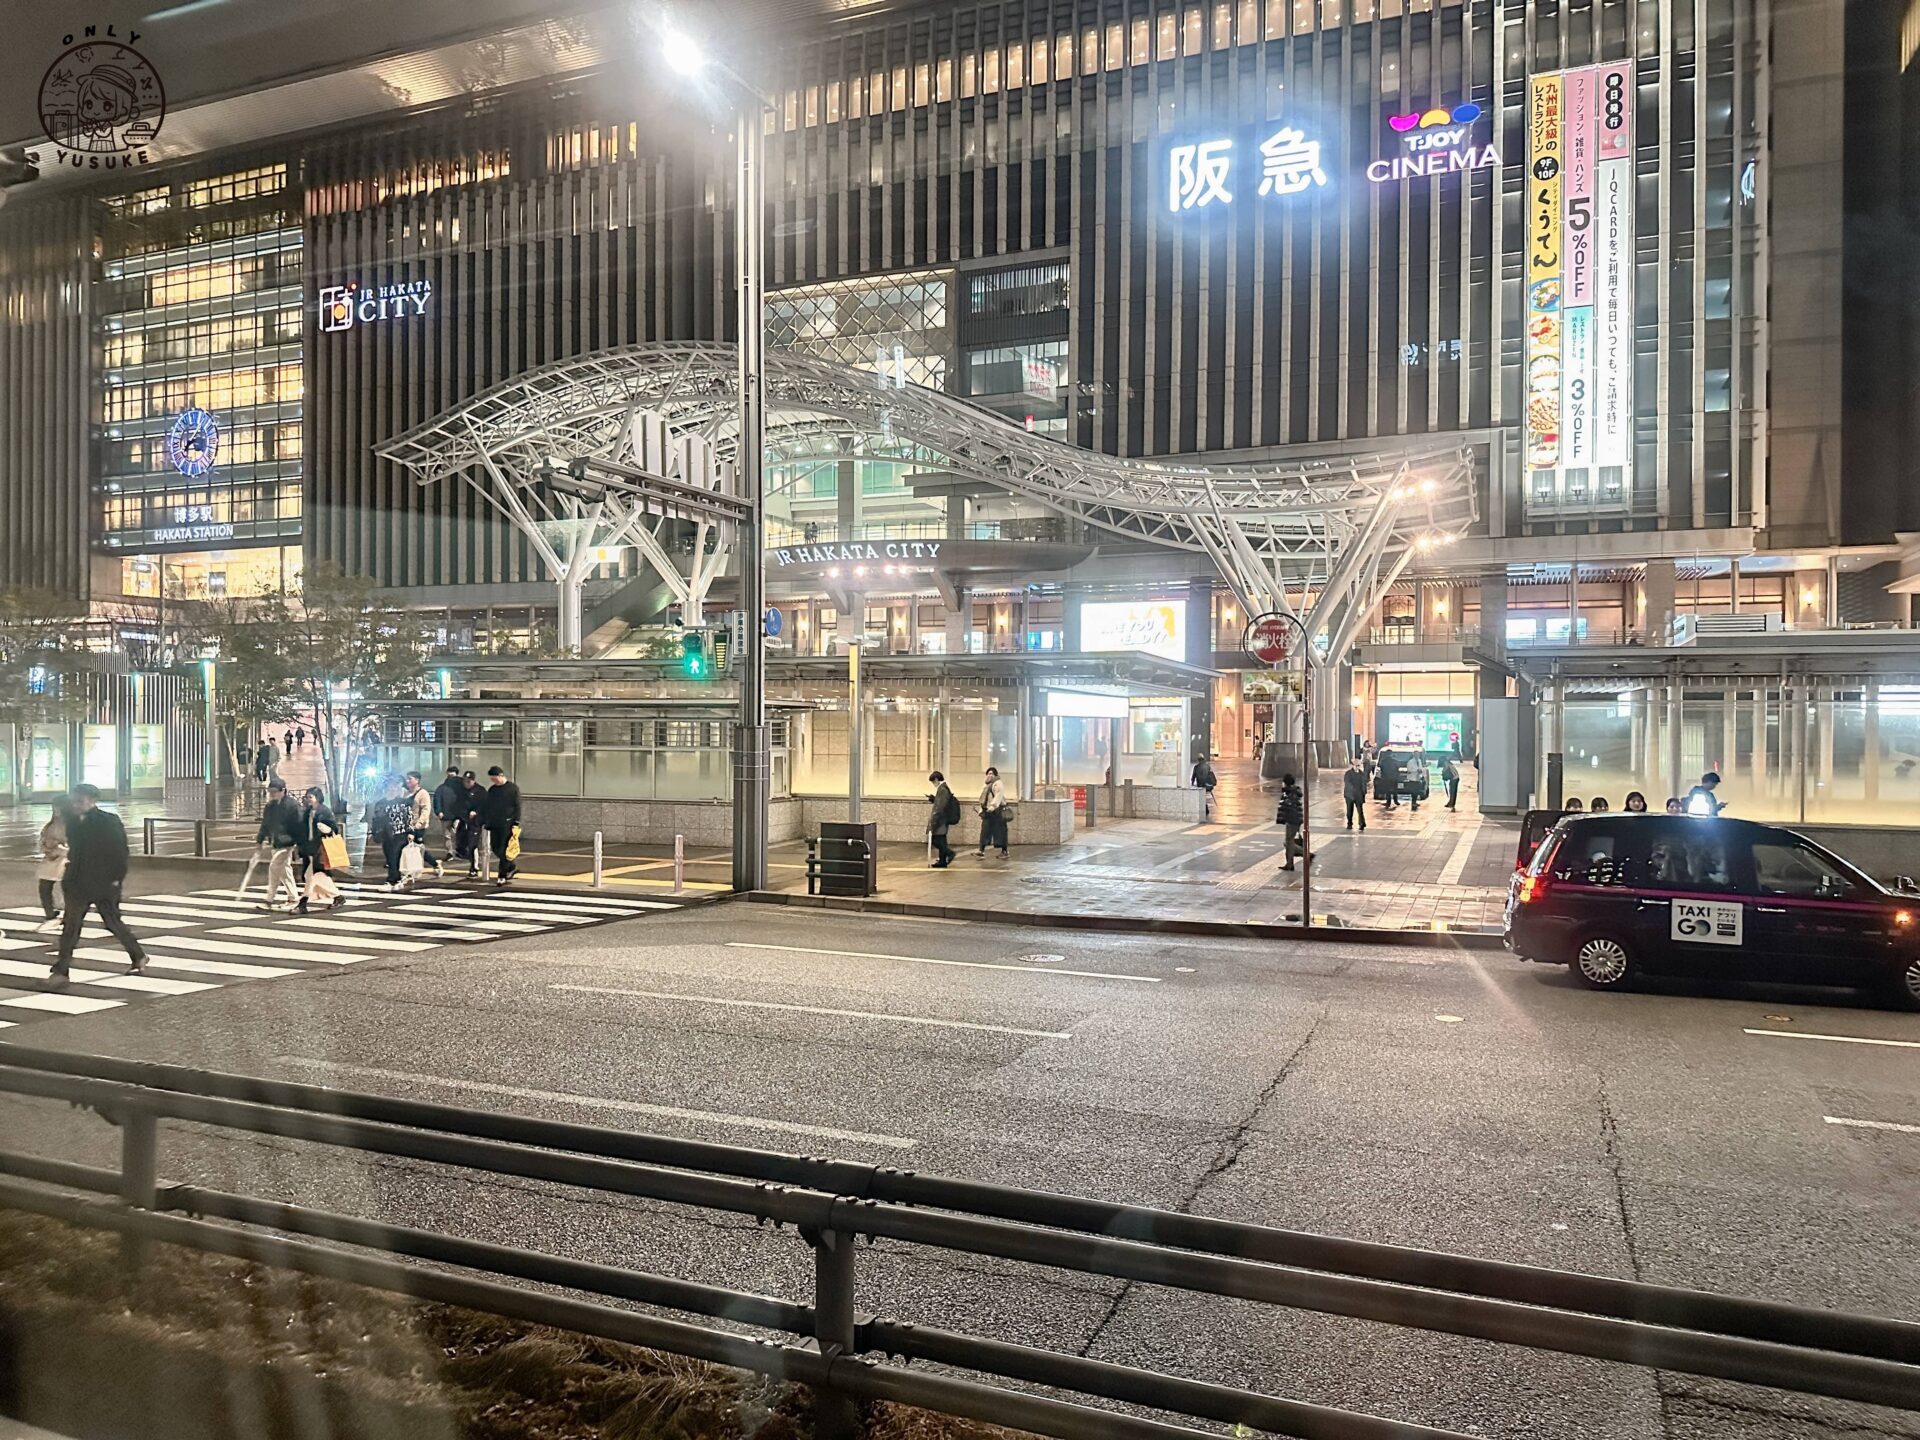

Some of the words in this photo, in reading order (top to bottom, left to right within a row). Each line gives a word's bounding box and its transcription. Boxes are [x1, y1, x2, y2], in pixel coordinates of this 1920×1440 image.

[1534, 85, 1544, 153] レストランゾーン
[1545, 83, 1558, 151] 九州最大級の
[1169, 126, 1328, 213] 阪急
[1366, 143, 1504, 183] CINEMA
[1538, 170, 1555, 180] 10F
[1540, 158, 1553, 168] 9F
[1533, 188, 1558, 268] くうてん
[360, 289, 373, 302] JR
[379, 280, 432, 298] HAKATA
[358, 292, 432, 322] CITY
[1571, 378, 1585, 459] 3%OFF
[173, 505, 213, 523] 博多駅
[154, 528, 193, 541] HAKATA
[194, 524, 234, 539] STATION
[774, 549, 796, 567] JR
[796, 544, 879, 563] HAKATA
[886, 543, 941, 558] CITY
[1677, 905, 1711, 917] TAXI
[1677, 918, 1711, 937] GO
